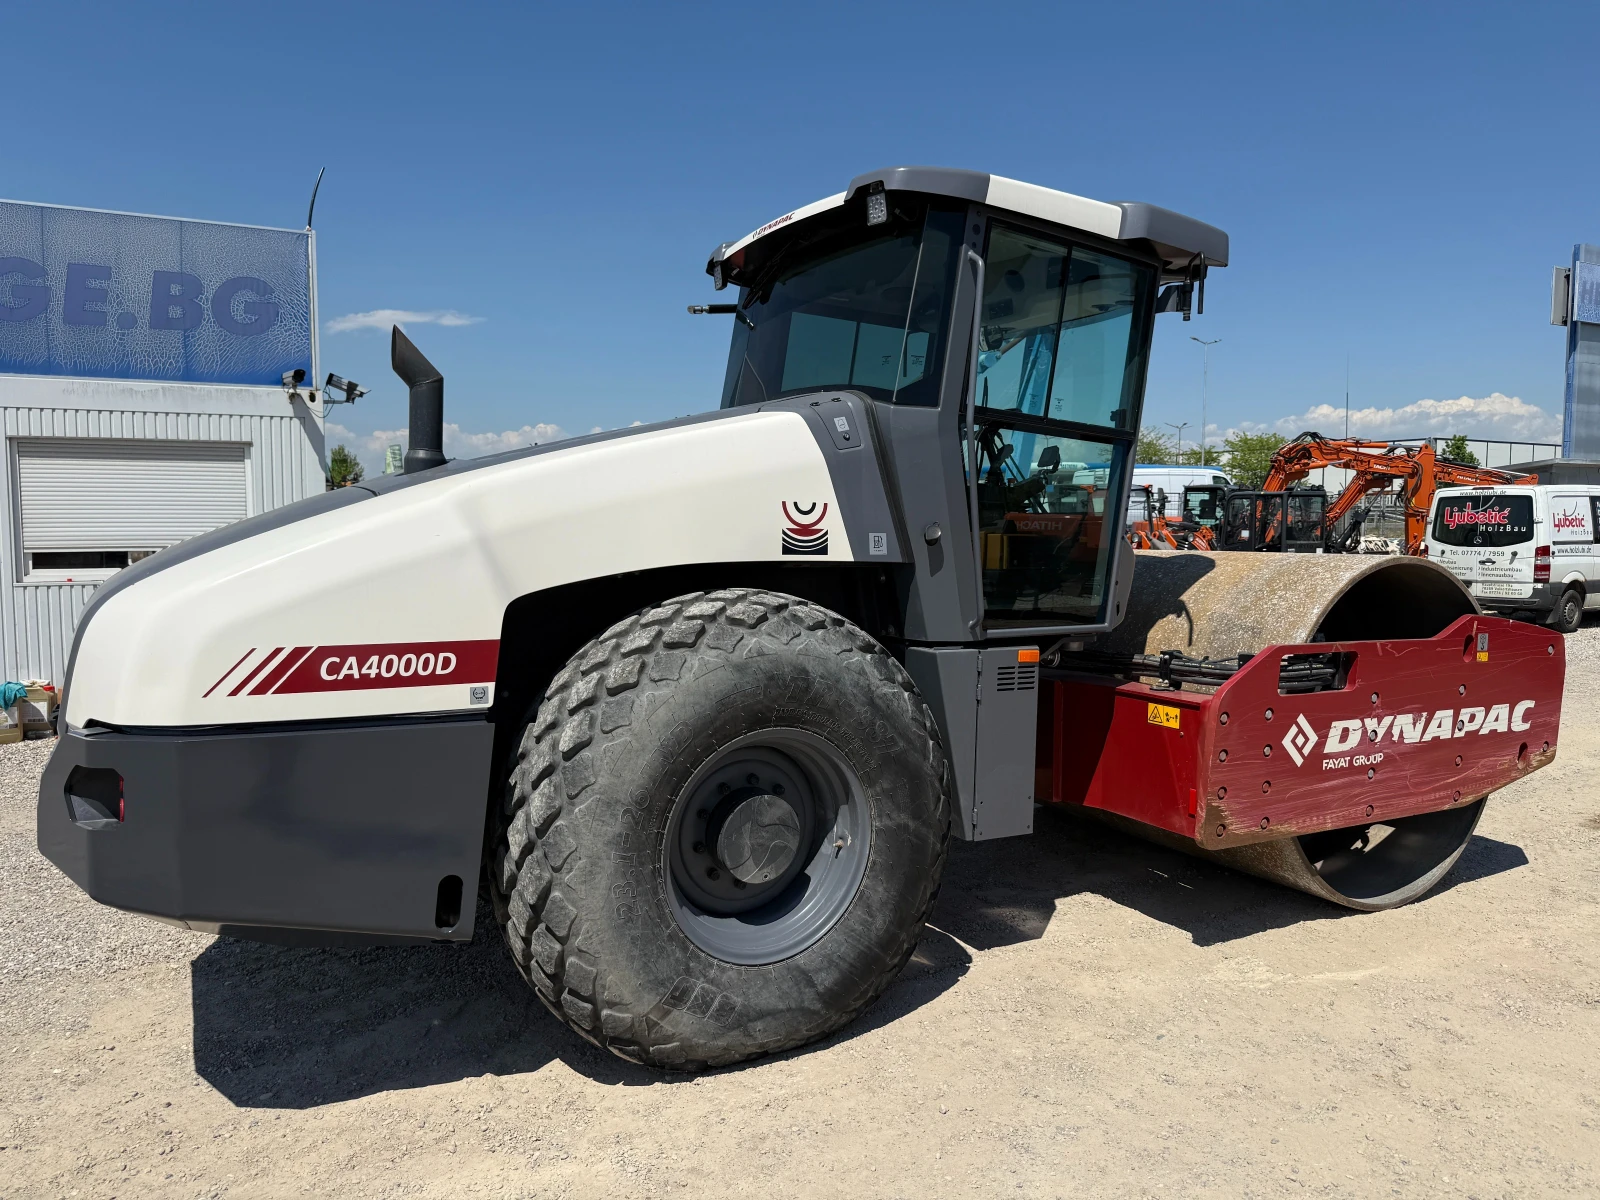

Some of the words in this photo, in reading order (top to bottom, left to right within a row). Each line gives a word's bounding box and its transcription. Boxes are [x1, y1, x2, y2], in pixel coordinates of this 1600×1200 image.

[319, 652, 457, 681] CA4000D
[1323, 700, 1536, 754] DYNAPAC
[1322, 756, 1350, 770] FAYAT
[1353, 752, 1384, 767] GROUP
